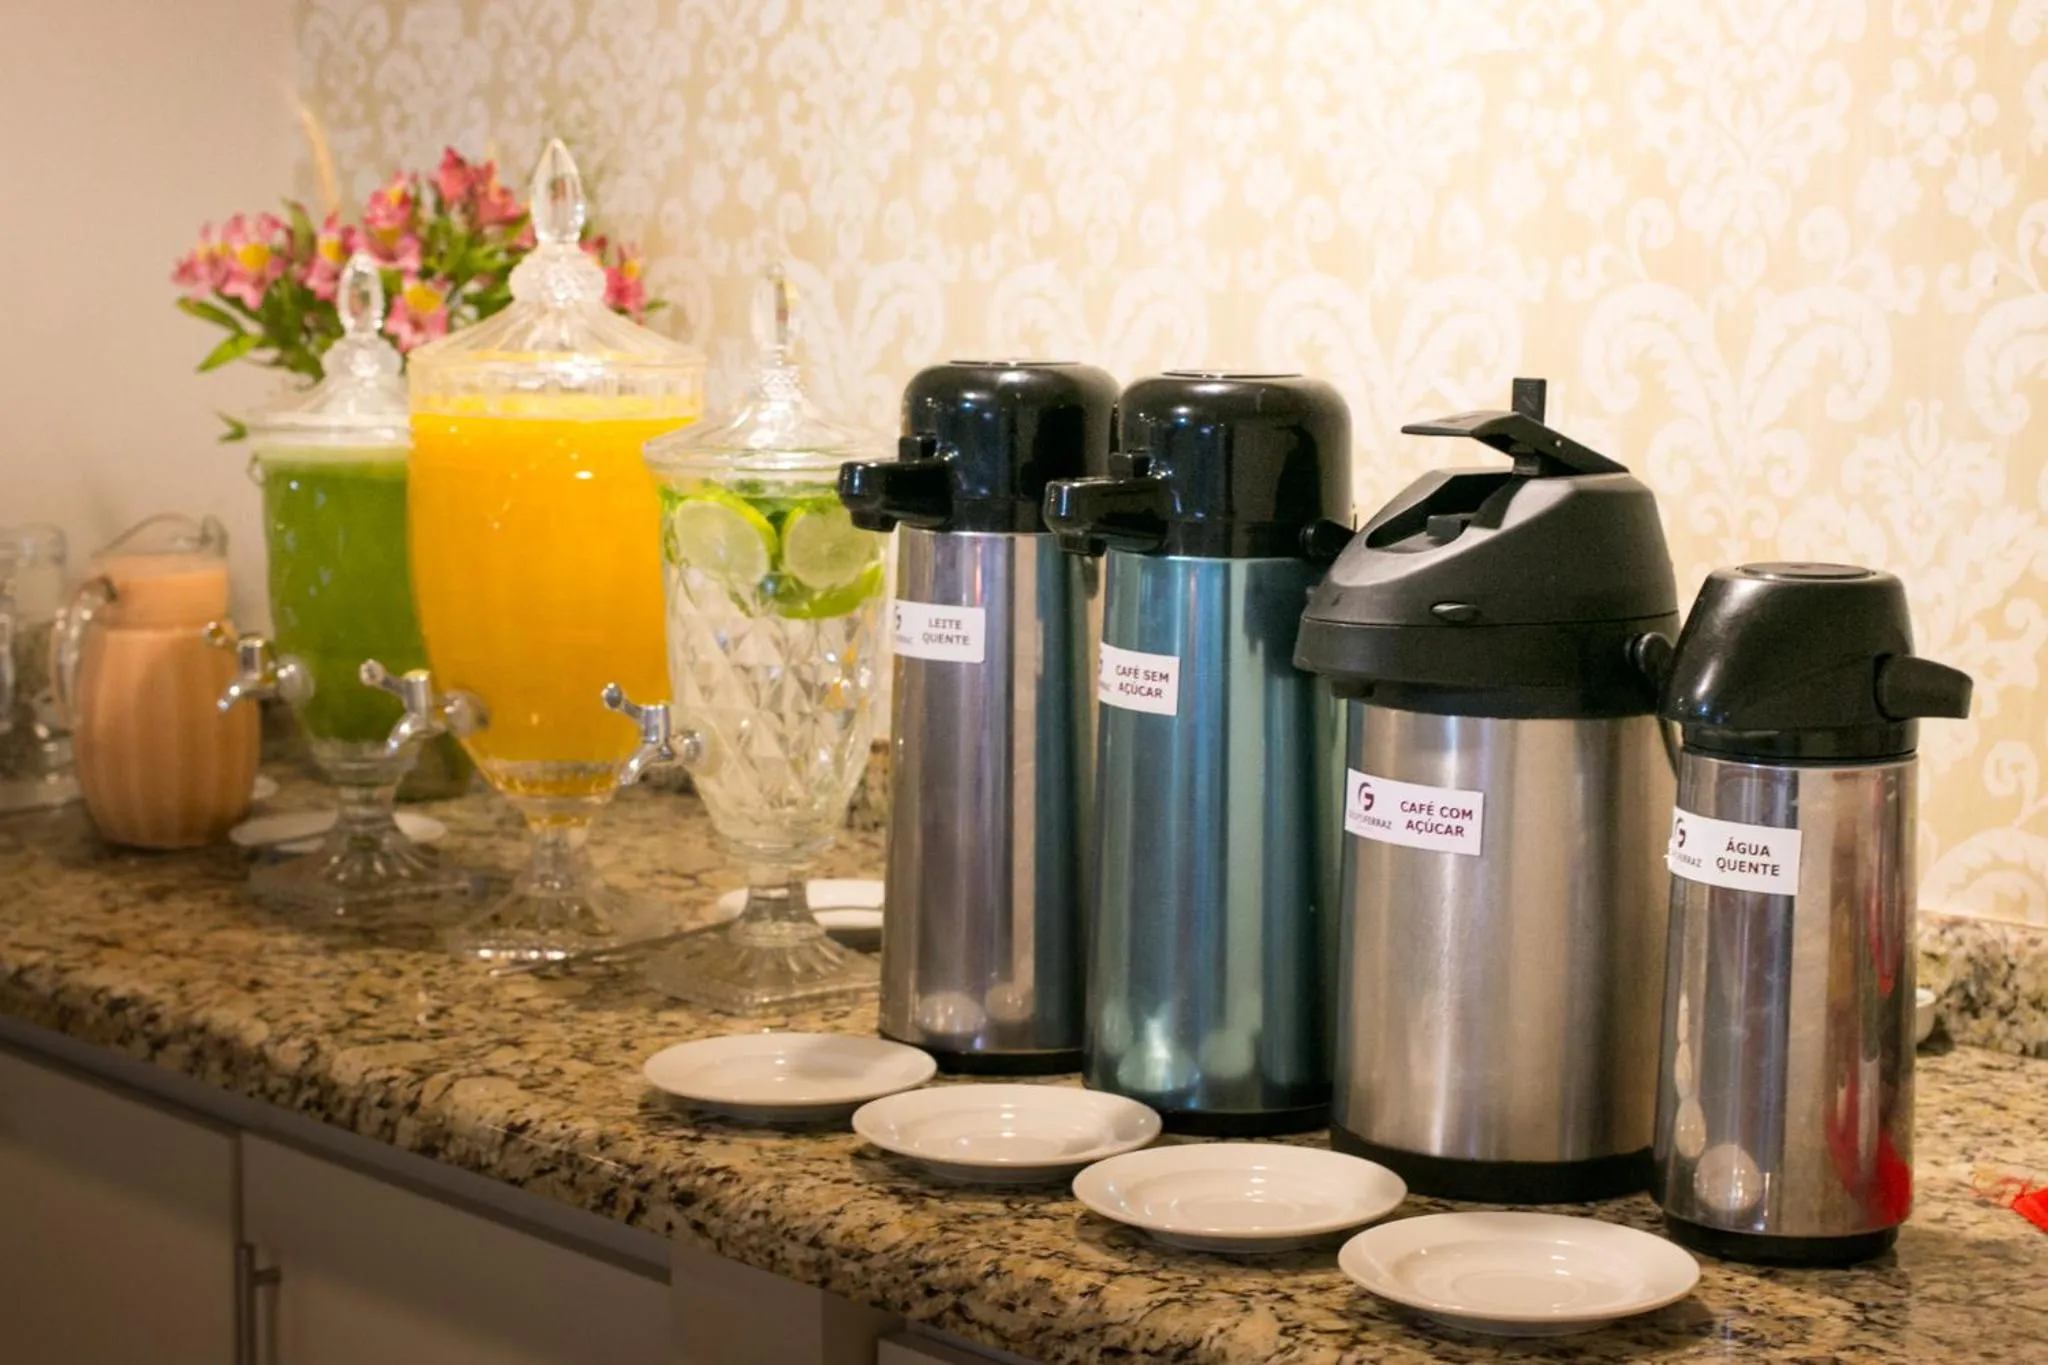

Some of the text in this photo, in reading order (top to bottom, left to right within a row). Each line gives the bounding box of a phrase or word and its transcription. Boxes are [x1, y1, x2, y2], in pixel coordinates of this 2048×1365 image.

[928, 617, 962, 630] LEITE
[922, 632, 971, 646] QUENTE
[1115, 664, 1140, 680] CAFÉ
[1143, 670, 1170, 683] SEM
[1119, 681, 1163, 698] AÇÚCAR
[1400, 800, 1474, 821] CAFÉ COM
[1405, 818, 1465, 837] AÇÚCAR
[1725, 837, 1771, 857] ÁGUA
[1716, 857, 1781, 877] QUENTE
